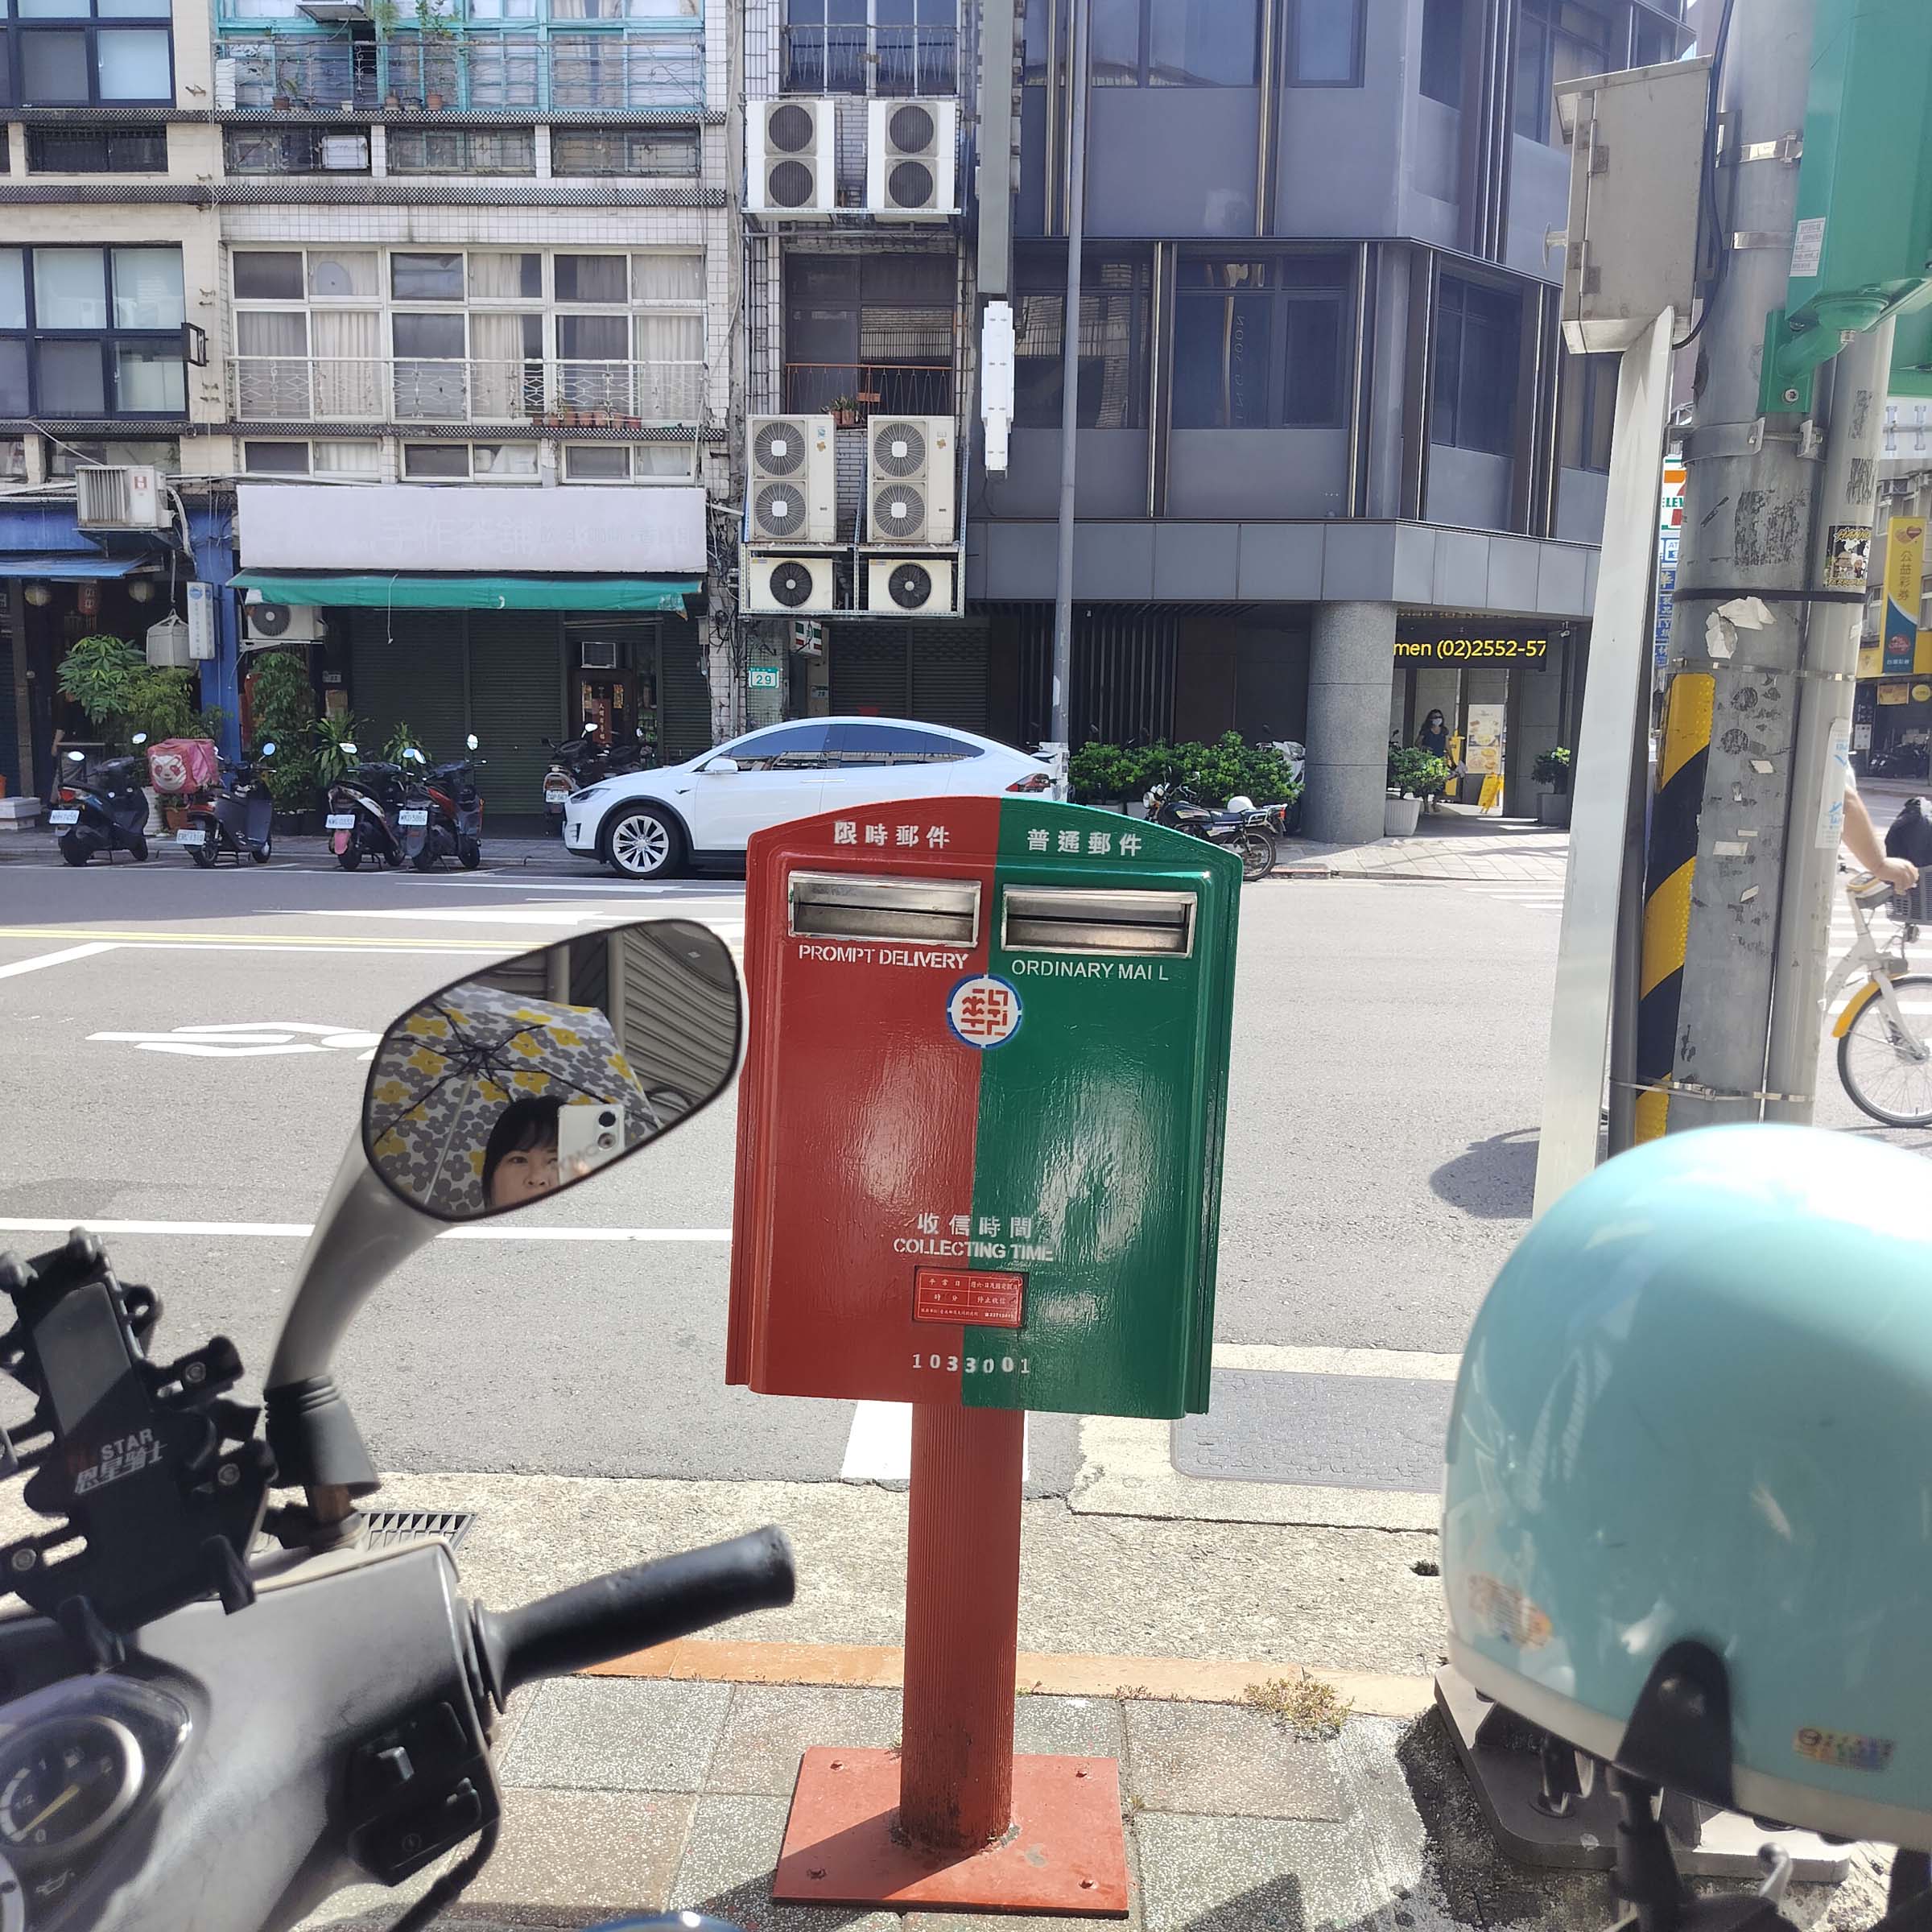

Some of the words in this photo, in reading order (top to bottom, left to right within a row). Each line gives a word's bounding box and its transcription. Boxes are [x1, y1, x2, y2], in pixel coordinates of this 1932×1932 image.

[1393, 643, 1431, 656] men
[1437, 640, 1546, 659] (02)2552-57
[756, 675, 772, 684] 29
[834, 820, 950, 848] 限時郵件
[1027, 828, 1141, 857] 普通郵件
[799, 944, 875, 964] PROMPT
[879, 949, 968, 969] DELIVERY
[1011, 960, 1114, 979] ORDINARY
[917, 1212, 1032, 1239] 收信時間
[894, 1237, 1006, 1259] COLLECTING
[1009, 1245, 1054, 1261] TIME
[912, 1354, 1030, 1373] 1033001
[101, 1428, 153, 1461] STAR
